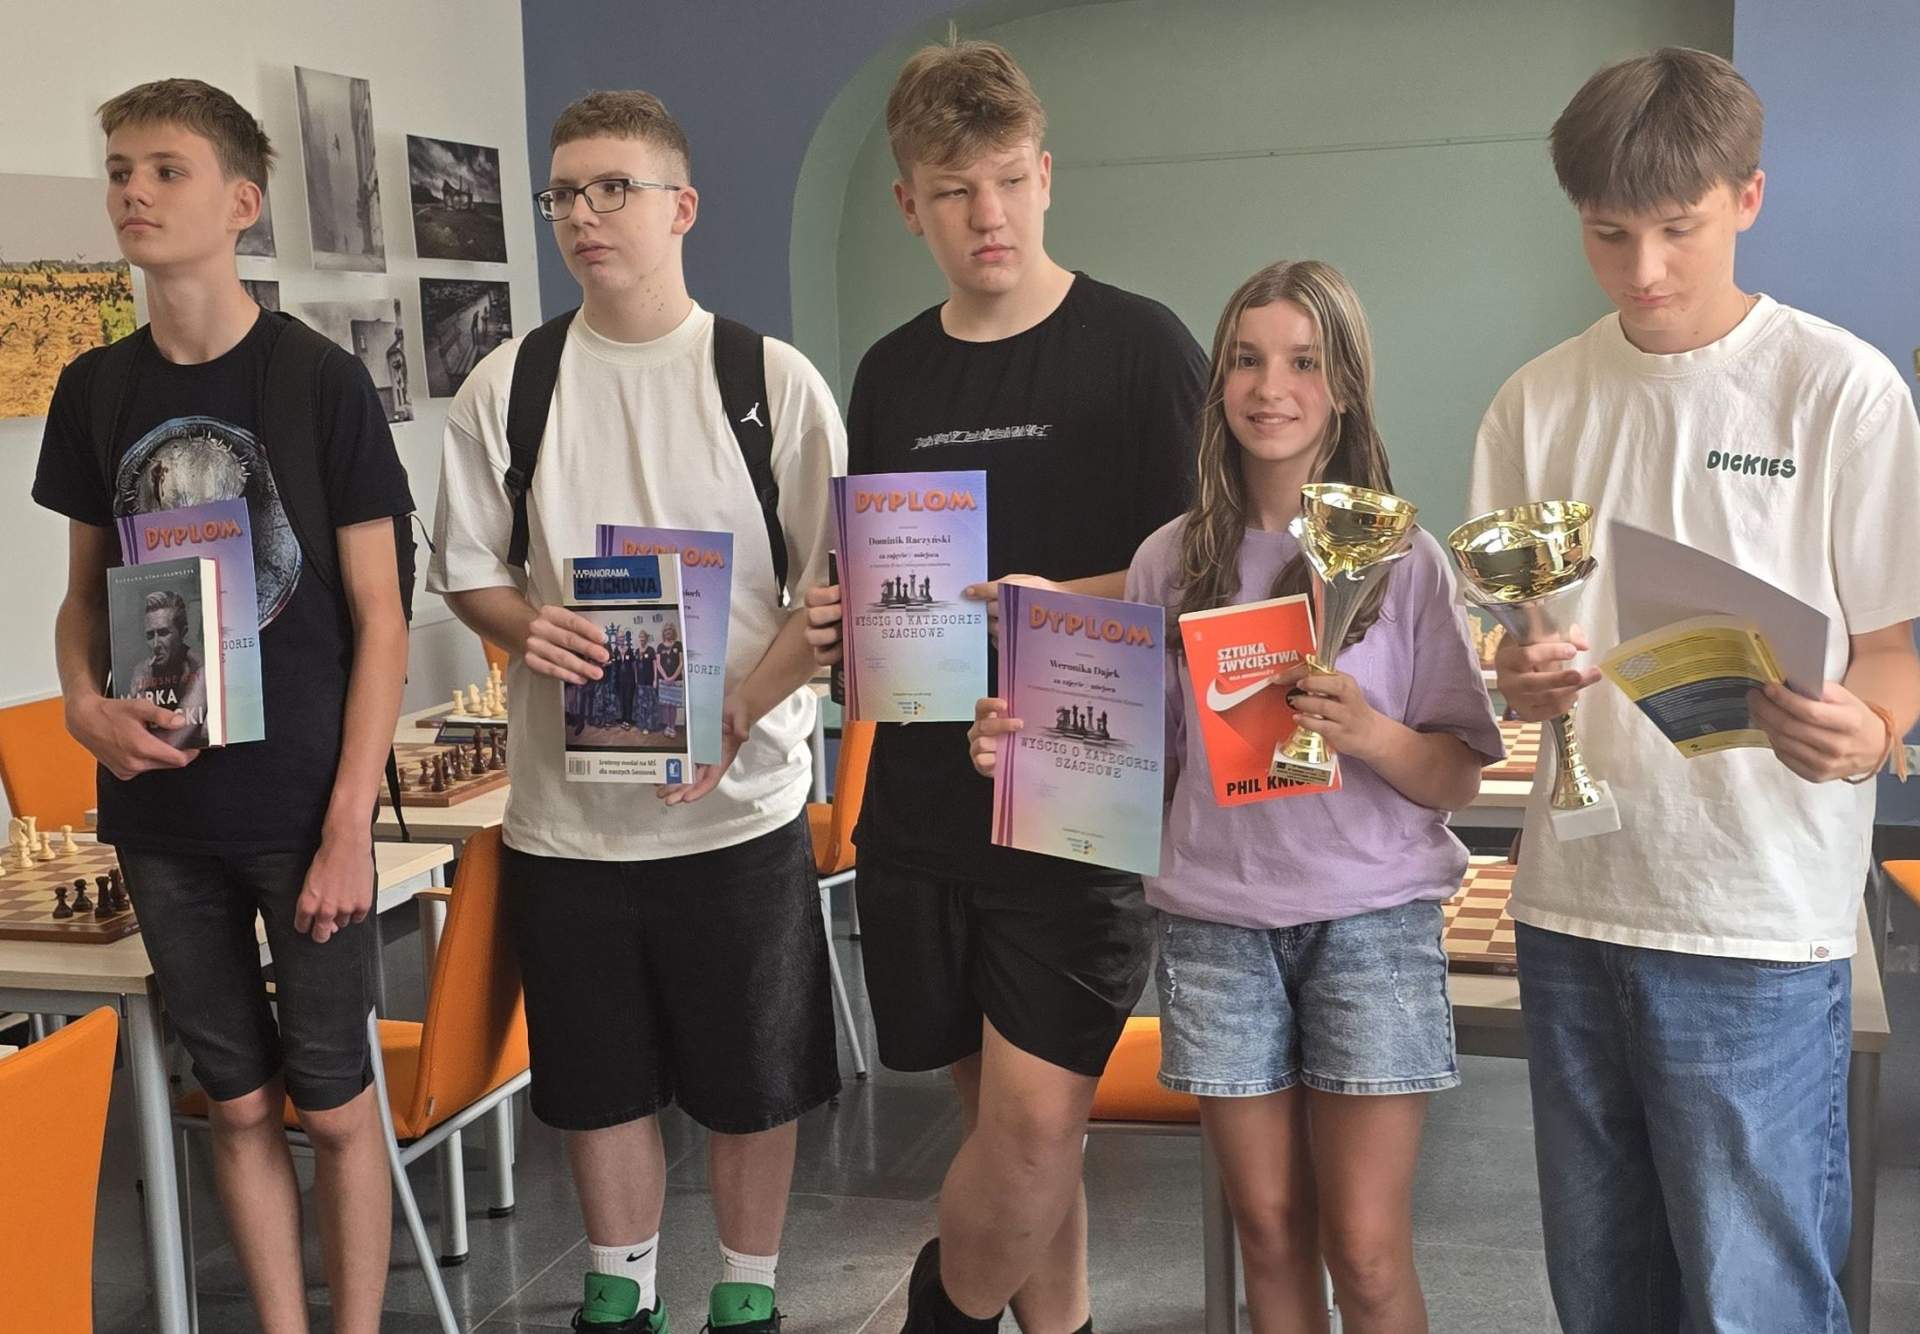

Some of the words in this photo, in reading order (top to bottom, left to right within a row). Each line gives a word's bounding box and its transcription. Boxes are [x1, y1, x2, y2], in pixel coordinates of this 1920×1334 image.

[1707, 450, 1796, 478] DICKIES
[854, 489, 977, 513] DYPLOM
[145, 520, 242, 550] DYPLOM
[868, 536, 904, 546] Dominik
[585, 568, 630, 578] PANORAMA
[577, 577, 657, 594] SZACHOWA
[896, 615, 903, 626] O
[906, 613, 982, 625] KATEGORIE
[1029, 602, 1155, 648] DYPLOM
[882, 627, 945, 639] SZACHOWE
[1217, 642, 1266, 660] SZTUKA
[1050, 659, 1092, 674] Weronika
[1218, 650, 1299, 674] ZWYCIĘSTWA
[1056, 757, 1122, 778] SZACHOWE
[1072, 746, 1080, 757] O
[1085, 748, 1160, 772] KATEGORIE
[1227, 778, 1262, 796] PHIL
[1267, 776, 1311, 790] KNI
